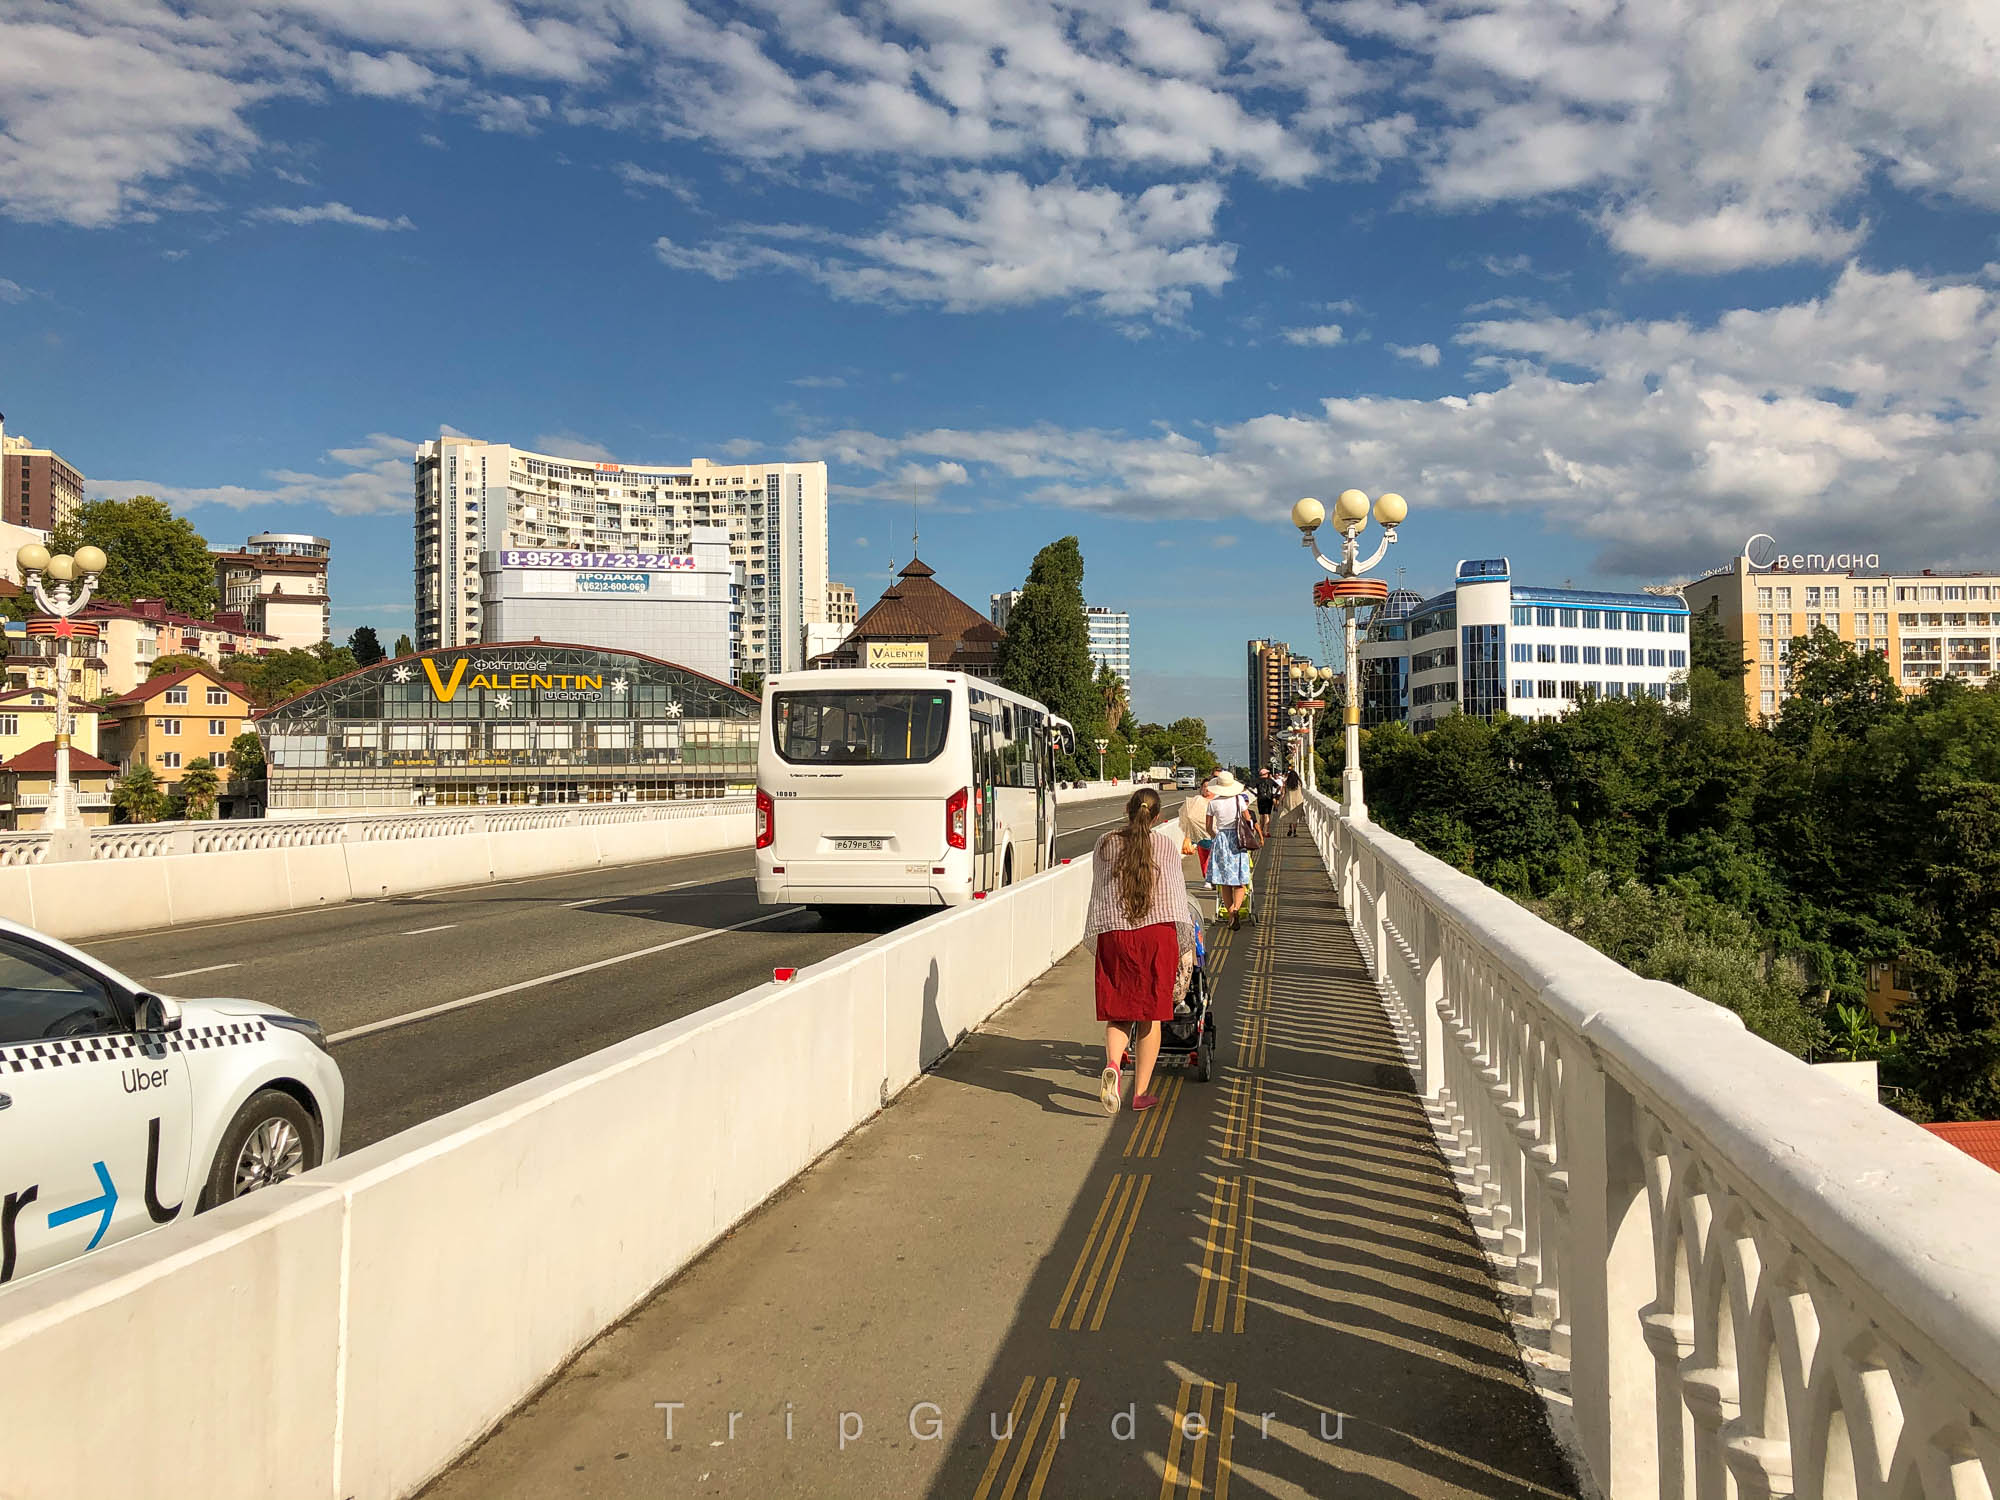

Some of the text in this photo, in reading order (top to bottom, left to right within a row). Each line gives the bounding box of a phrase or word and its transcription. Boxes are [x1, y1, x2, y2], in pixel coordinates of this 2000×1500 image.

[1745, 533, 1879, 572] Светлана
[577, 573, 644, 581] ПРОДАЖА
[873, 648, 924, 659] VALENTIN
[544, 691, 602, 702] центр
[122, 1067, 169, 1094] Uber
